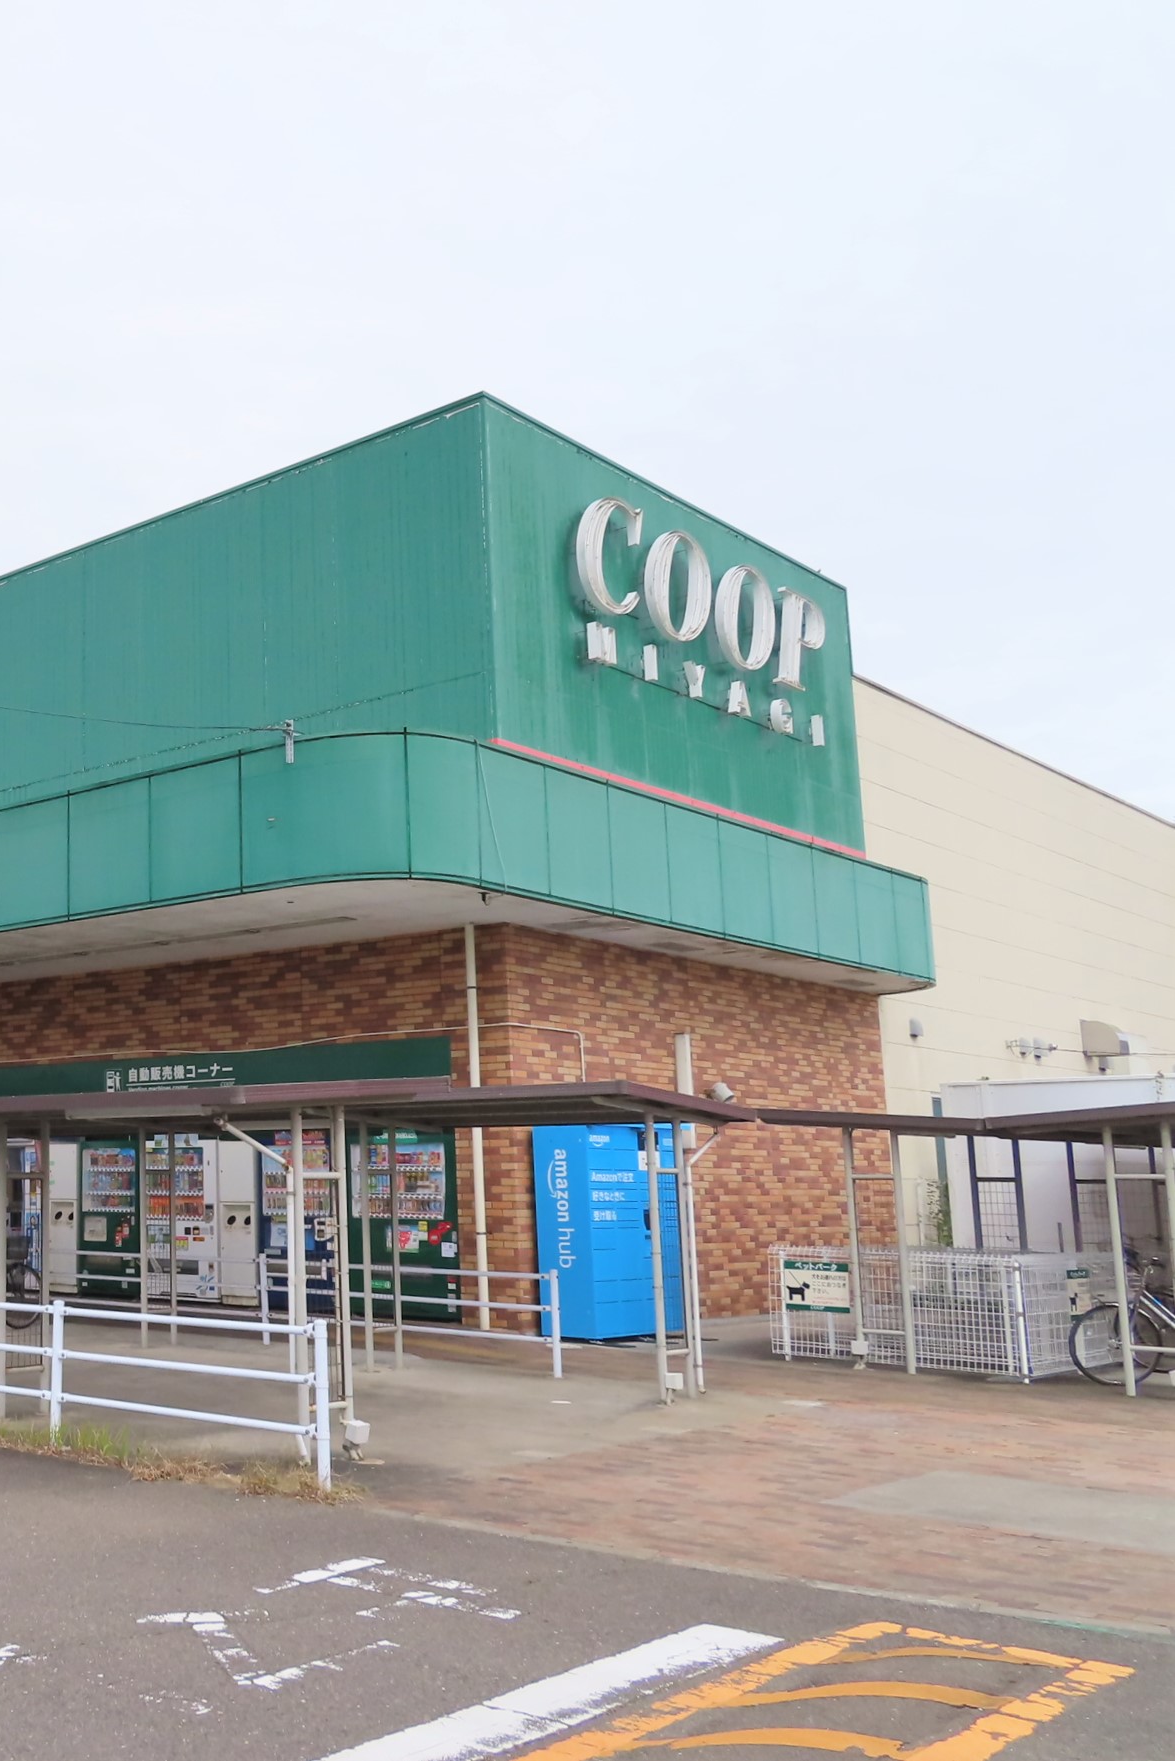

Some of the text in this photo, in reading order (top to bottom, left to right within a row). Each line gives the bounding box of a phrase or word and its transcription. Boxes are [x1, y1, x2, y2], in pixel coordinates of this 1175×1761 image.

[576, 497, 825, 691] COOP
[586, 621, 825, 746] MIYAGI
[128, 1063, 233, 1082] 自動販売機コーナー
[589, 1134, 610, 1143] amazon
[553, 1149, 576, 1268] amazon hub
[794, 1262, 838, 1271] ペットパーク
